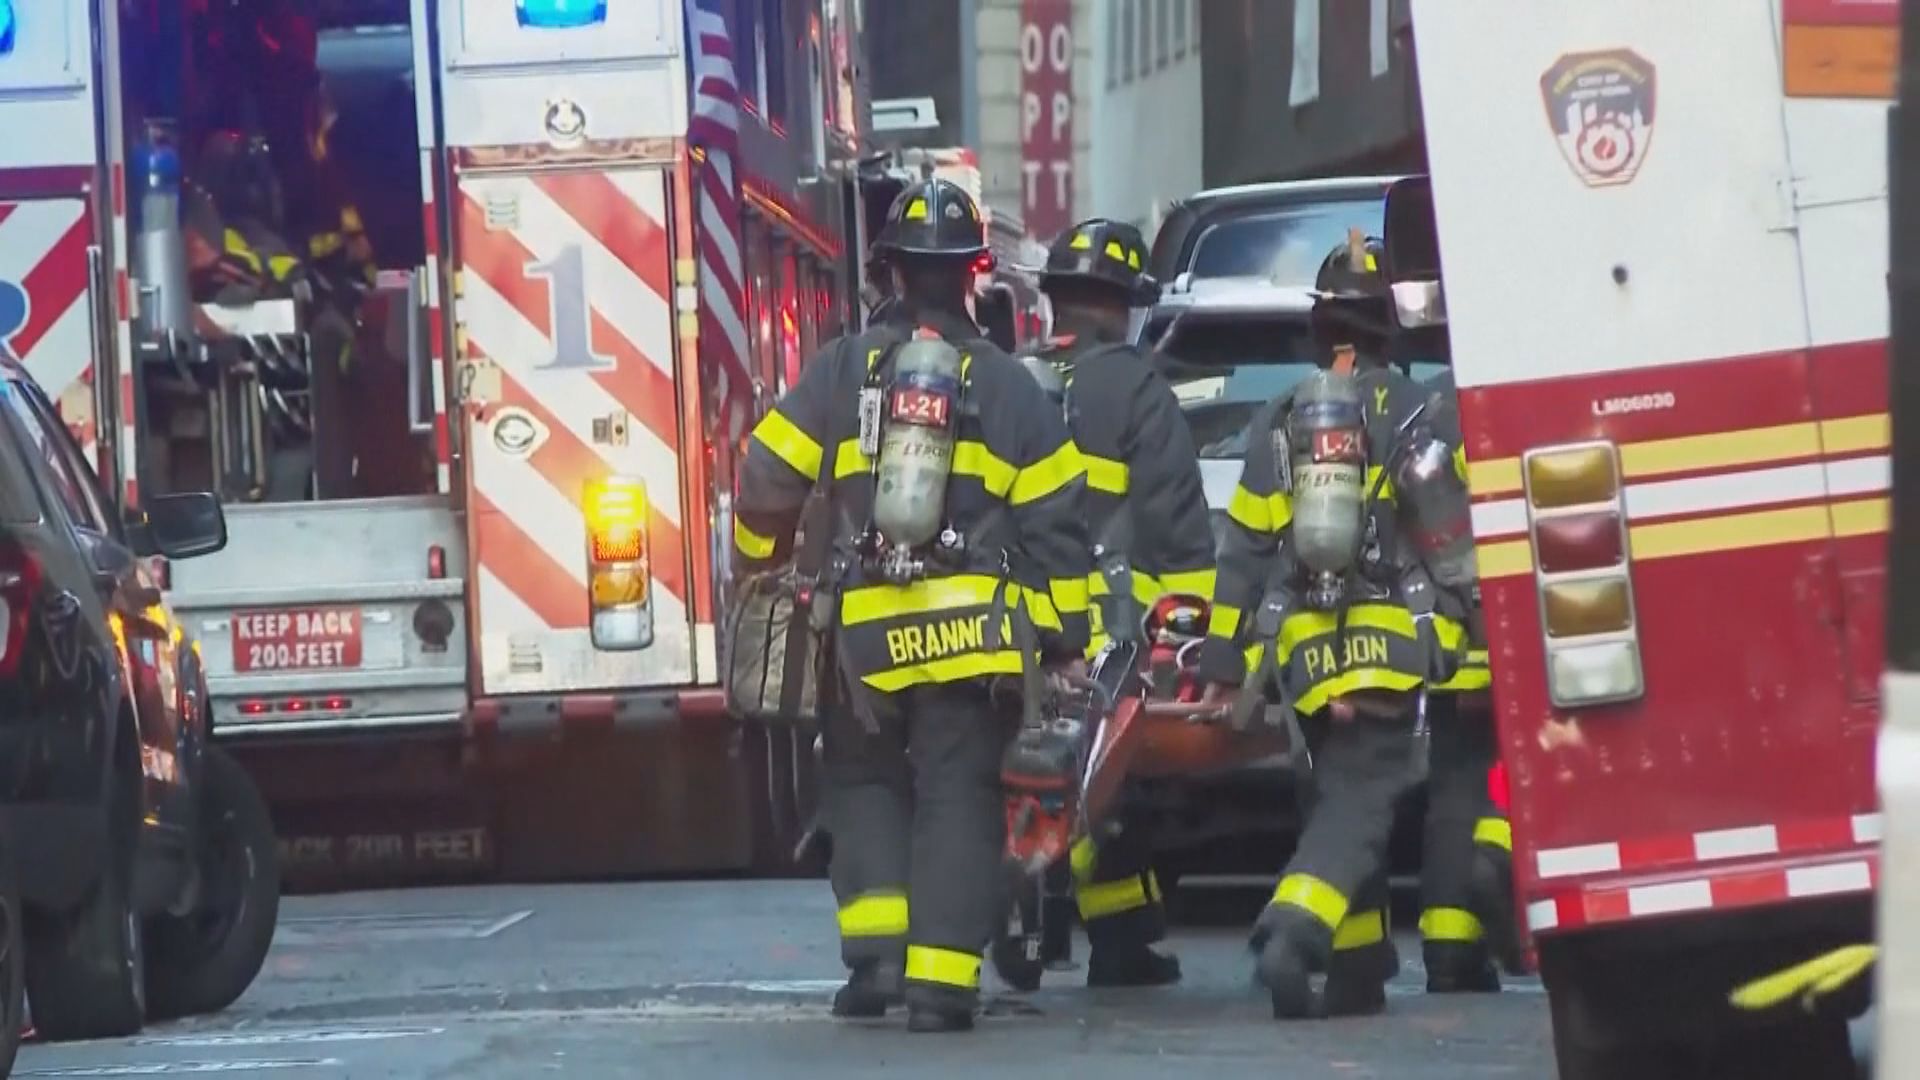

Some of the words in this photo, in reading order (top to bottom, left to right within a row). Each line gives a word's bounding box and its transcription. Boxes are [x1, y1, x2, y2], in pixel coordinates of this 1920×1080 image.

[523, 241, 618, 371] 1
[238, 613, 290, 638] KEEP
[296, 611, 353, 637] BACK
[249, 643, 289, 668] 200
[296, 641, 345, 665] FEET
[414, 827, 485, 859] FEET
